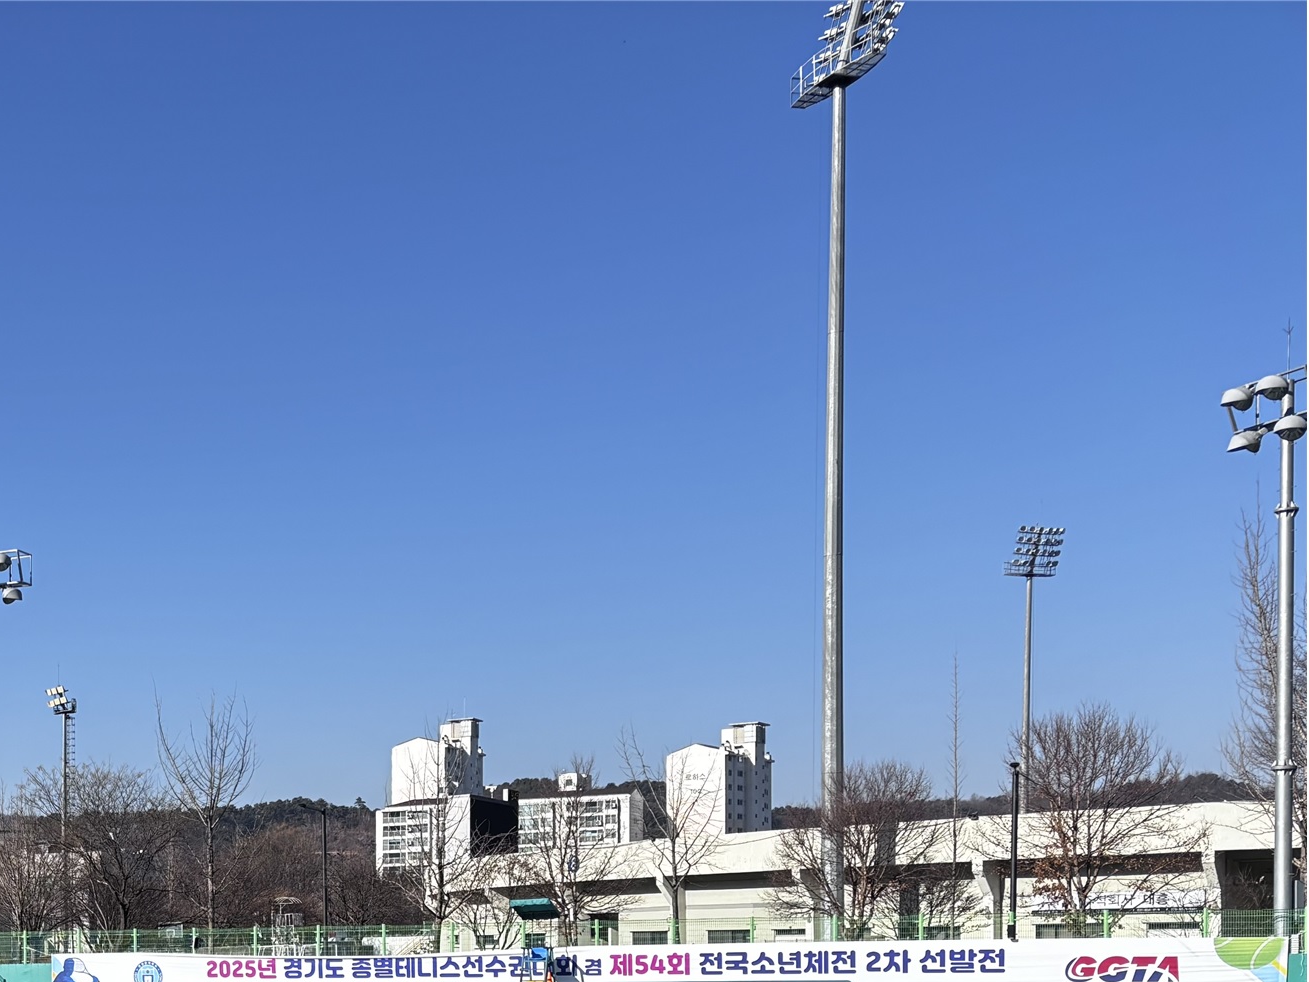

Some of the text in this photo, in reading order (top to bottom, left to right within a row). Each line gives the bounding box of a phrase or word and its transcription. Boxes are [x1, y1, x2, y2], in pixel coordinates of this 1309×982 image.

[206, 957, 277, 979] 2025년
[283, 957, 345, 979] 경기도
[584, 958, 602, 976] 겸
[609, 952, 691, 976] 제54회
[699, 950, 857, 976] 전국소년체전
[866, 949, 912, 974] 2차
[919, 948, 1006, 973] 선발전
[1065, 955, 1180, 982] GGTA
